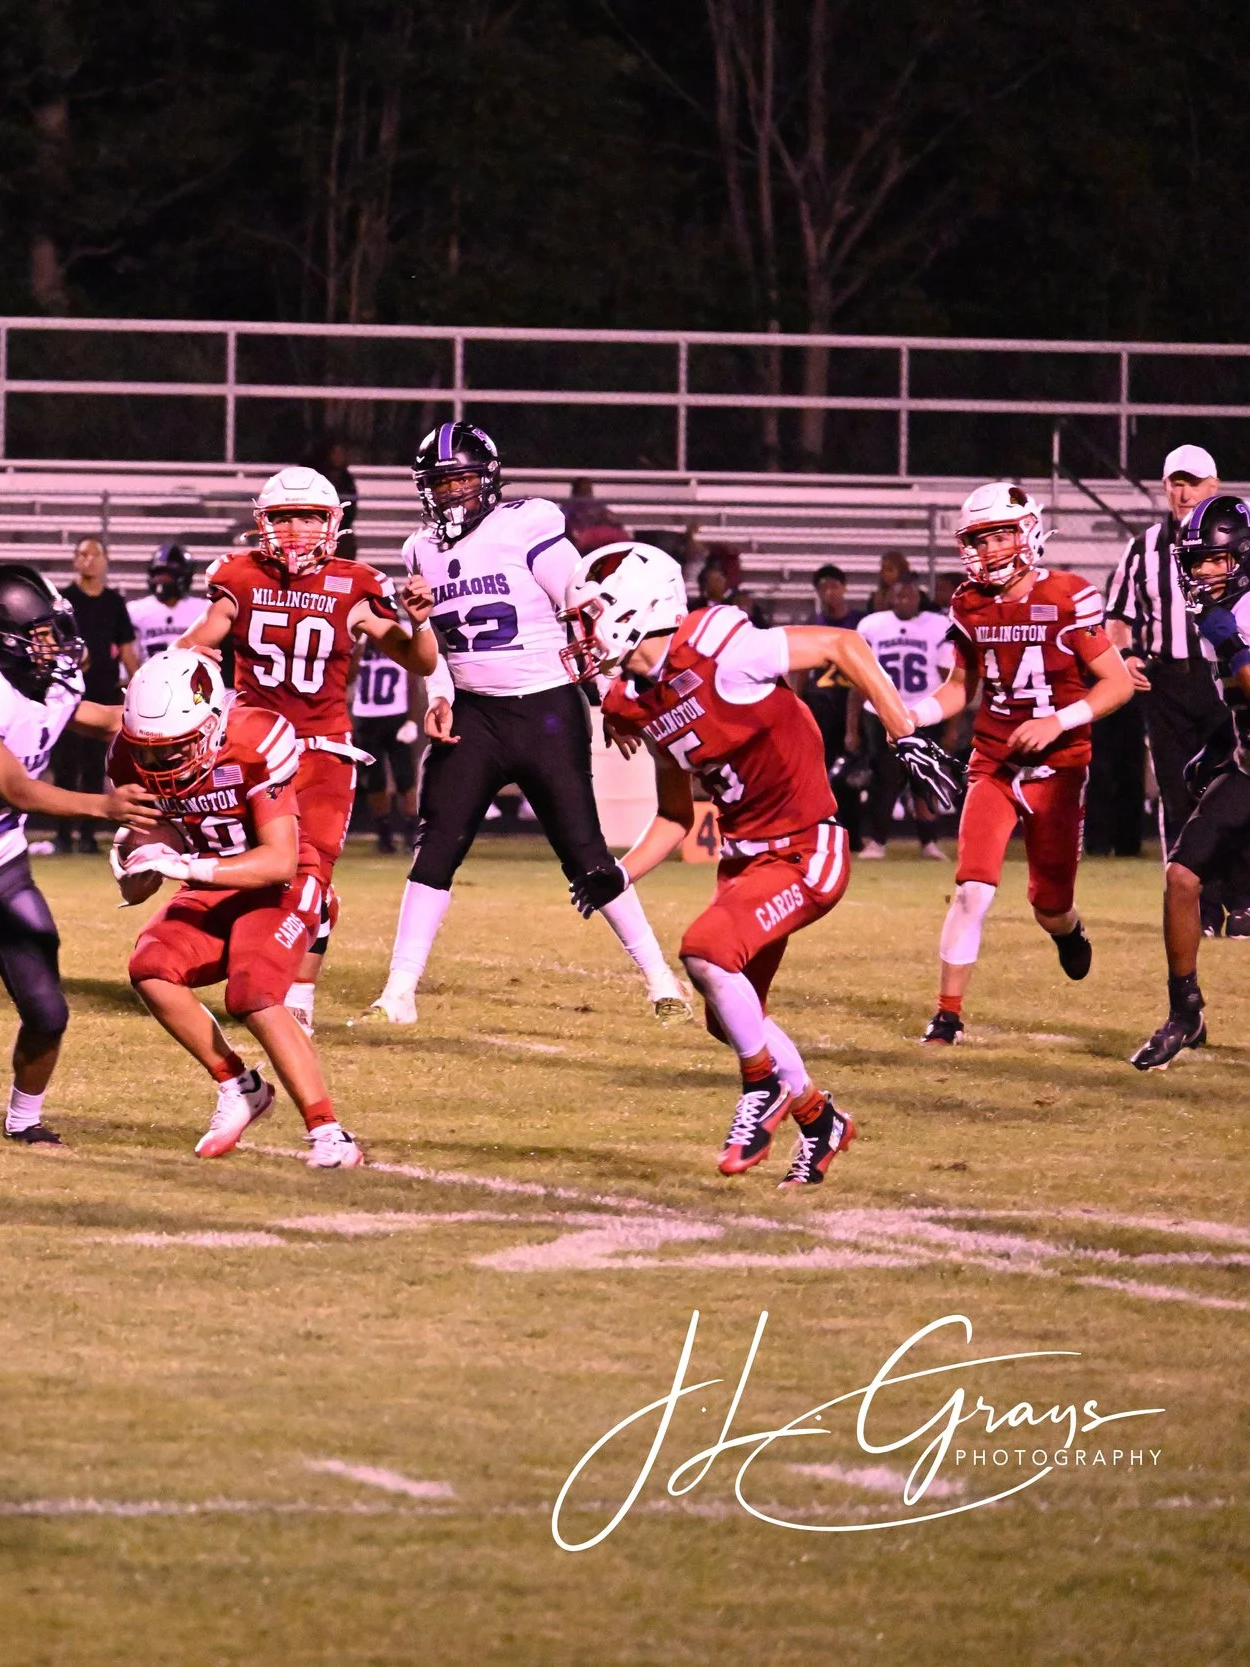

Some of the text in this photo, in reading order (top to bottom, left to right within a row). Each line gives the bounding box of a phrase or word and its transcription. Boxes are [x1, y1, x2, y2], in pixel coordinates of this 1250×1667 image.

[252, 587, 337, 614] MILLINGTON
[248, 609, 335, 695] 50
[358, 665, 400, 706] 10
[984, 645, 1056, 718] 14
[667, 730, 745, 804] 5
[697, 811, 717, 856] 4
[274, 912, 306, 950] CARDS
[755, 883, 804, 933] CARDS
